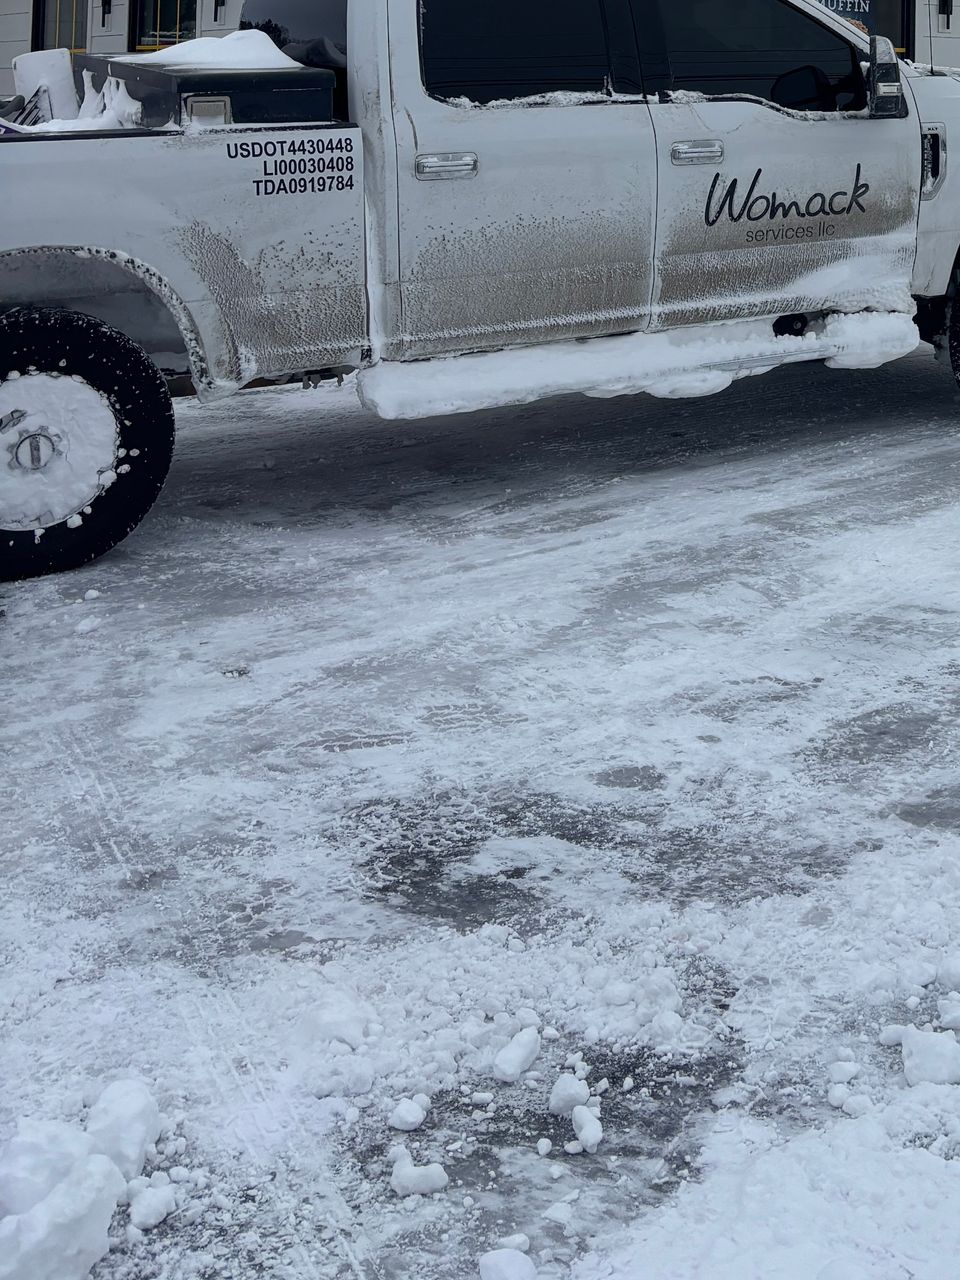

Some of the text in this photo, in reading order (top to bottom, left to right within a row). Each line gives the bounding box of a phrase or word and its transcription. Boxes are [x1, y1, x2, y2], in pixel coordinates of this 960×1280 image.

[226, 137, 353, 158] USDOT4430448
[263, 156, 354, 176] LI00030408
[253, 175, 354, 196] TDA0919784
[704, 163, 869, 226] Womack
[745, 221, 835, 243] services llc
